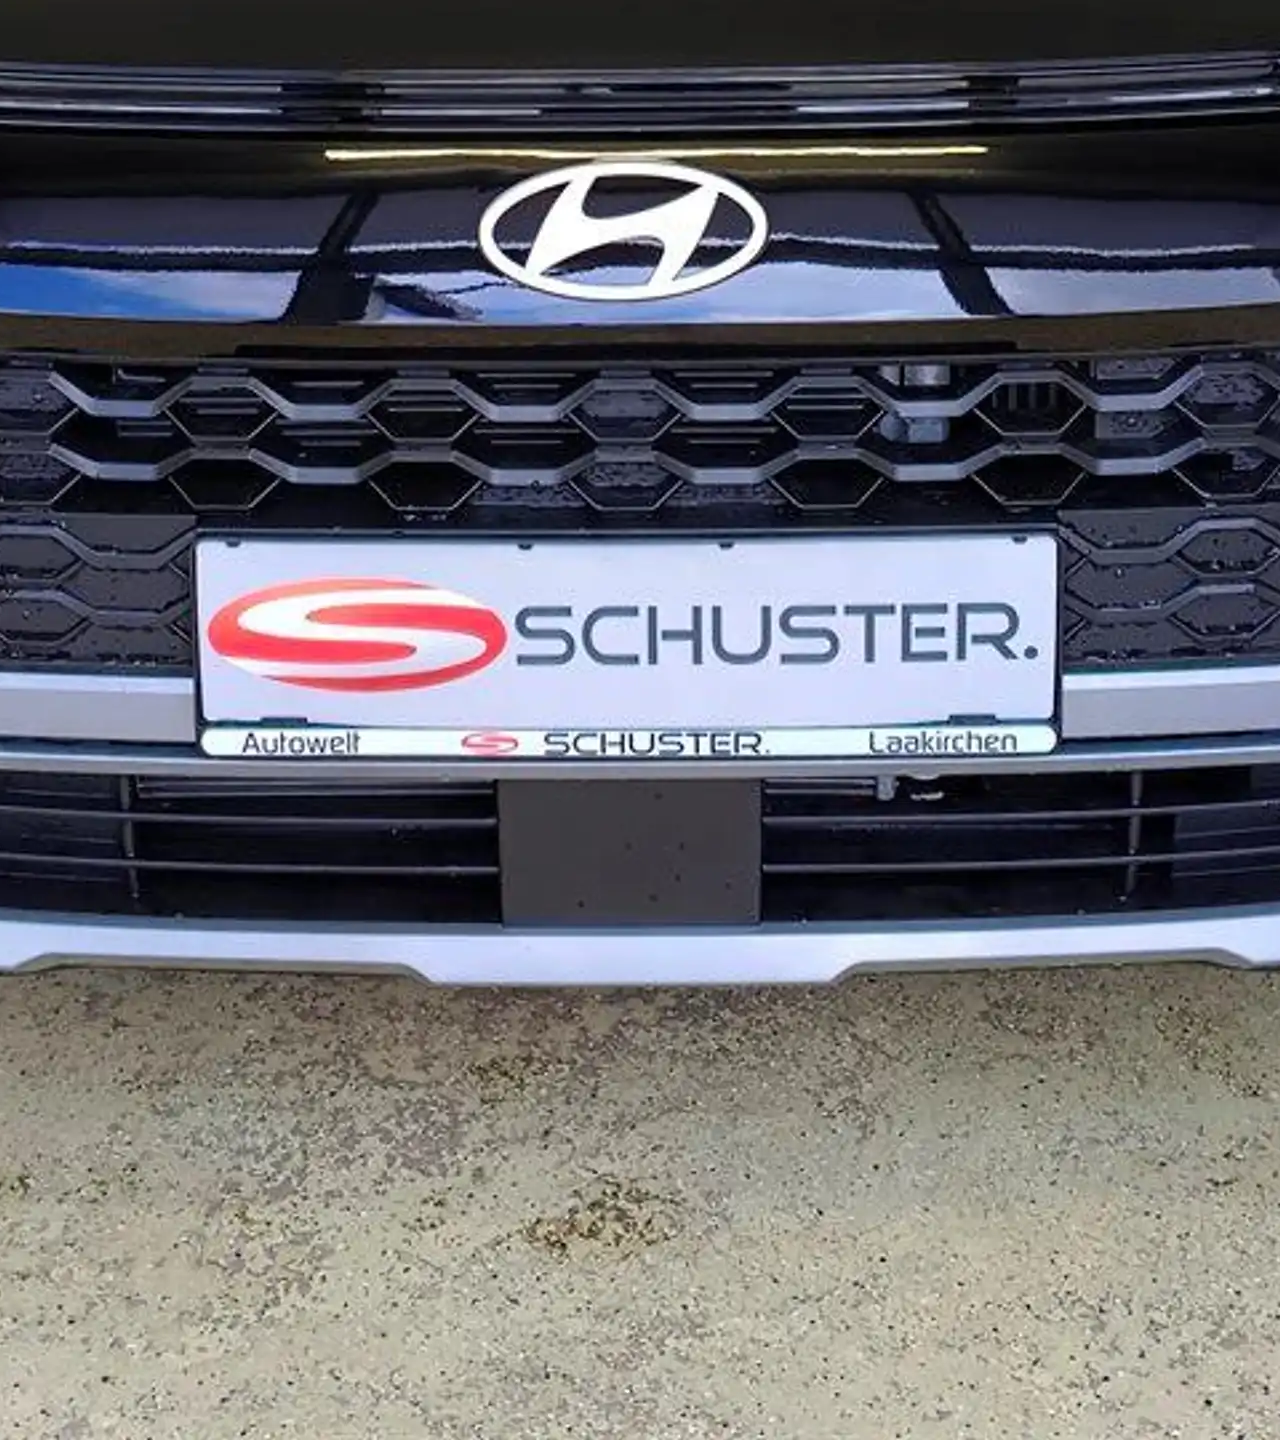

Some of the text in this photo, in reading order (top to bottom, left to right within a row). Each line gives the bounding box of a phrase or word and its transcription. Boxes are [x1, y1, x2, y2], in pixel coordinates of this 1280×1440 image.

[514, 602, 1039, 666] SCHUSTER.
[241, 731, 361, 754] Autowelt
[542, 731, 771, 756] SCHUSTER.
[868, 730, 1018, 753] Laakirchen
